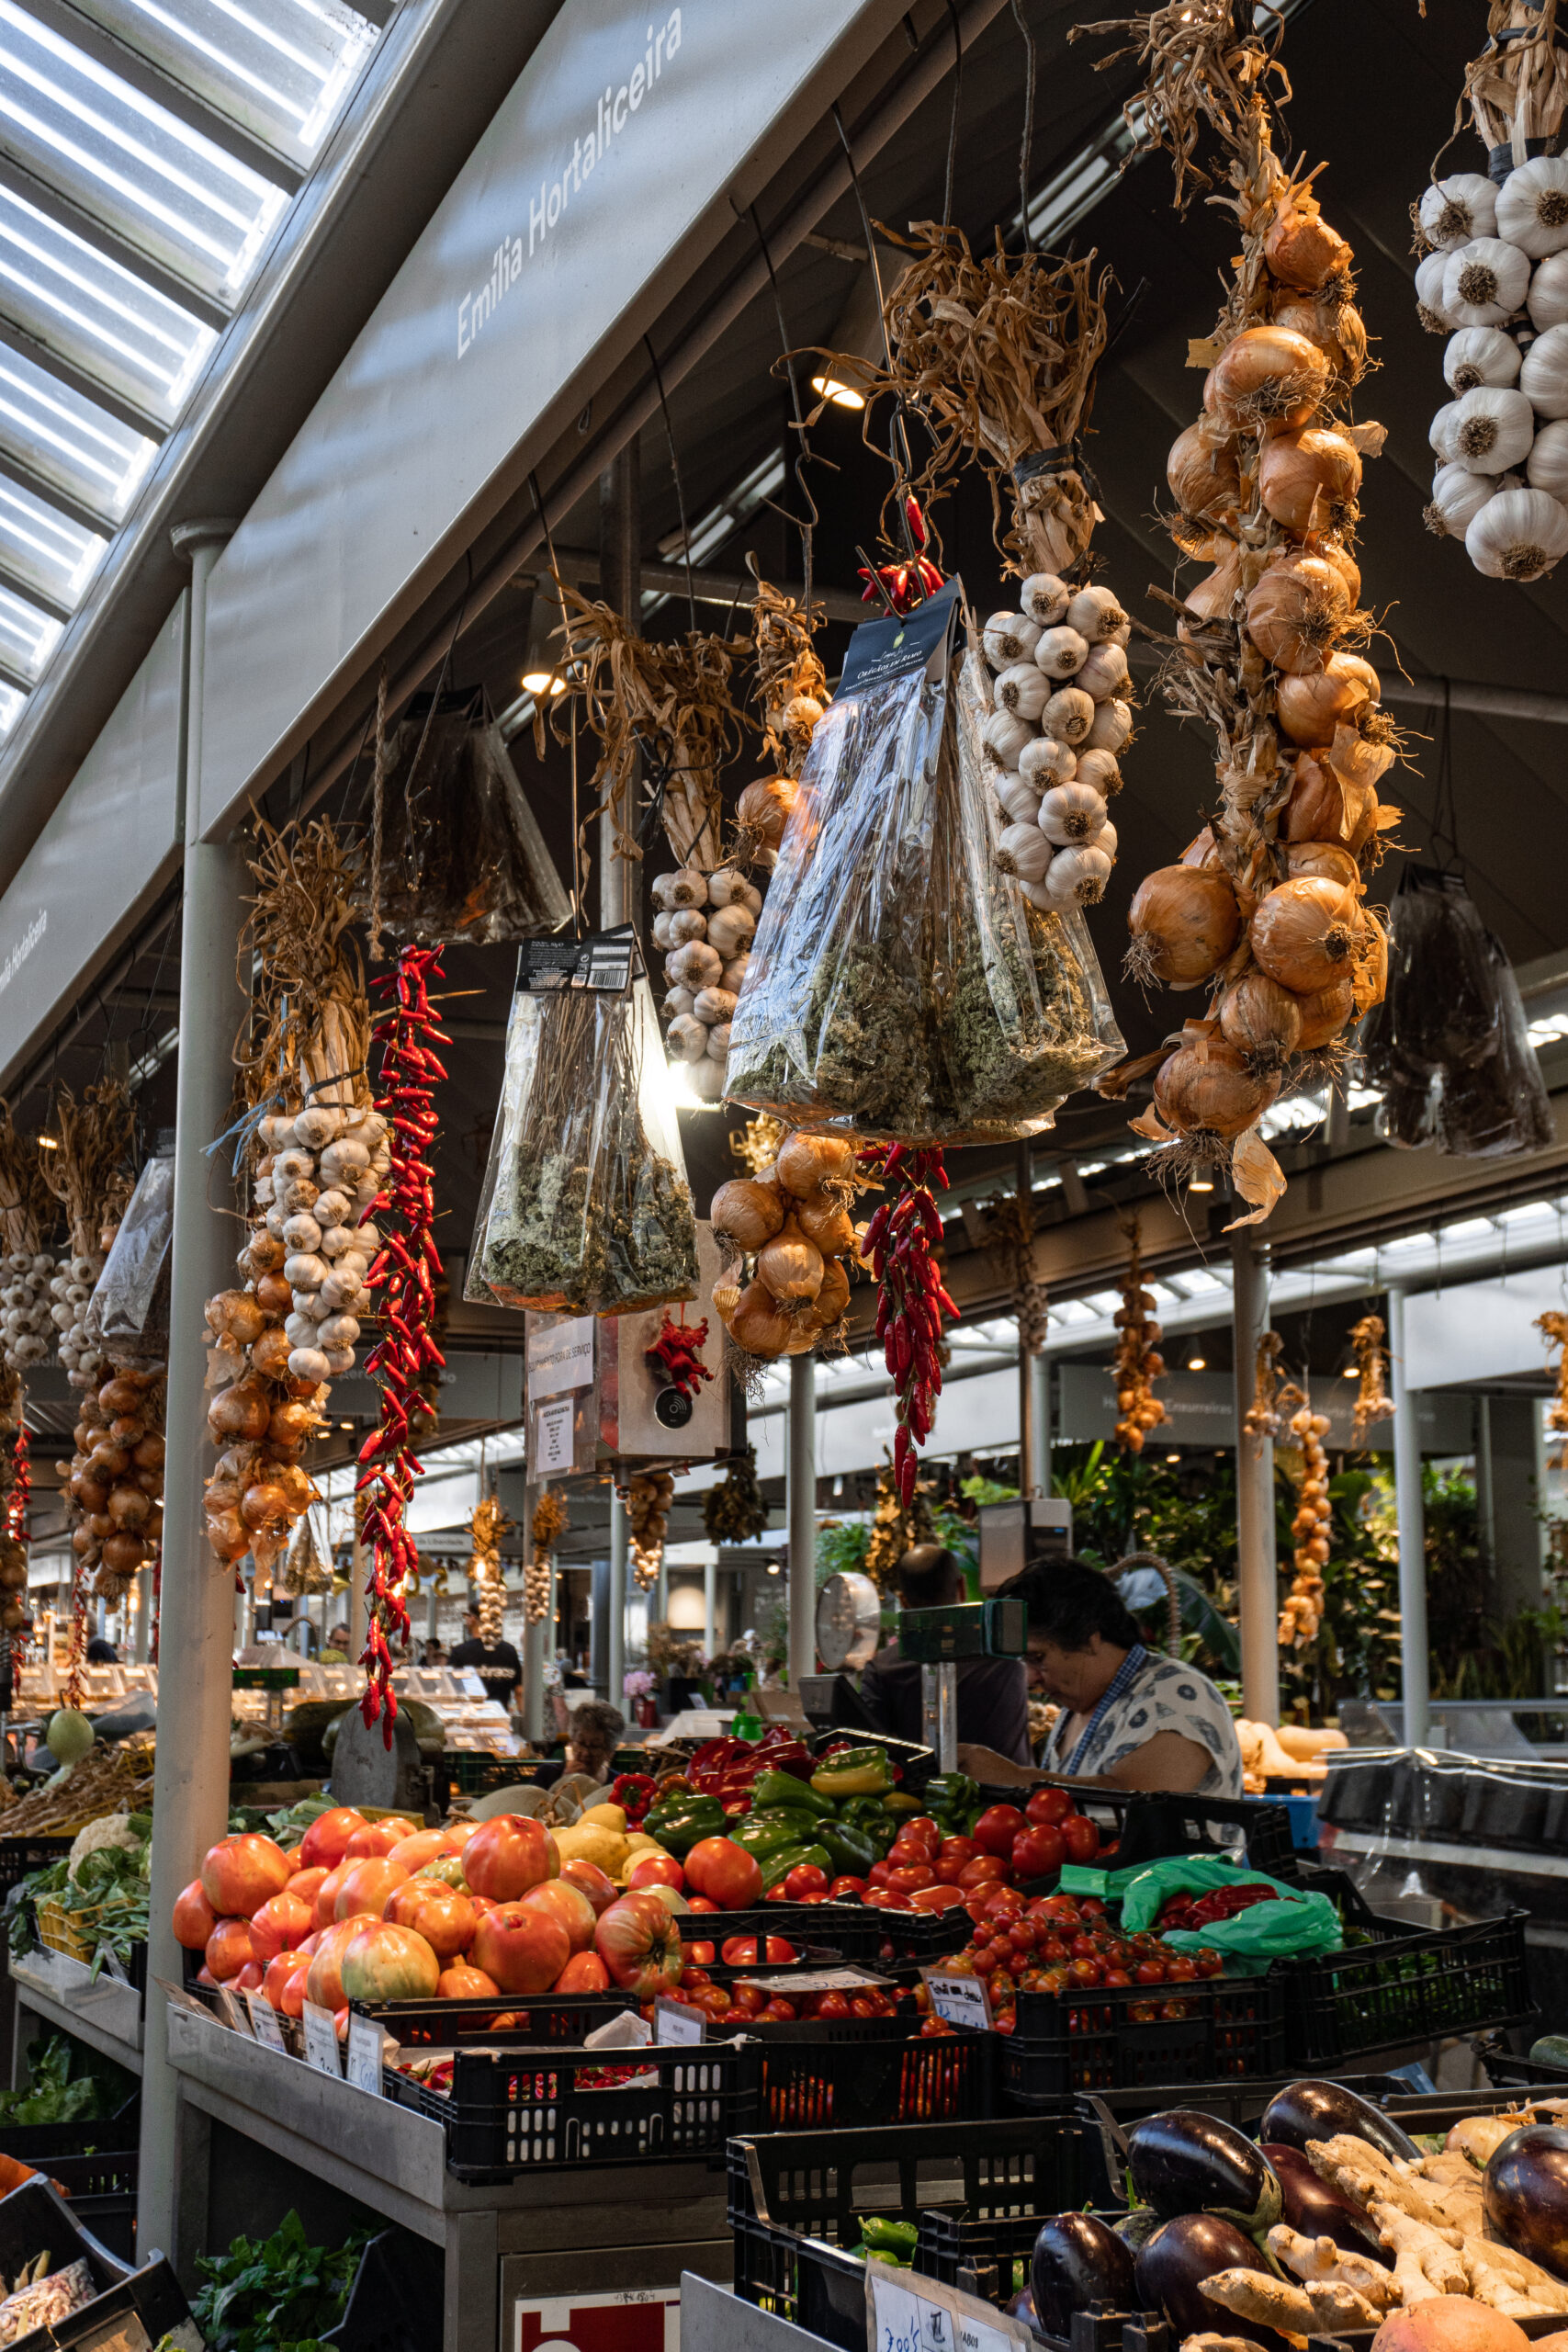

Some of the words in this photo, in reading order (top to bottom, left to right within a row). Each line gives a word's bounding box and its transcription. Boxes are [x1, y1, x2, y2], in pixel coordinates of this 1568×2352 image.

[457, 235, 523, 359] Emília
[529, 7, 682, 257] Hortaliceira
[960, 2331, 978, 2349] ABOS
